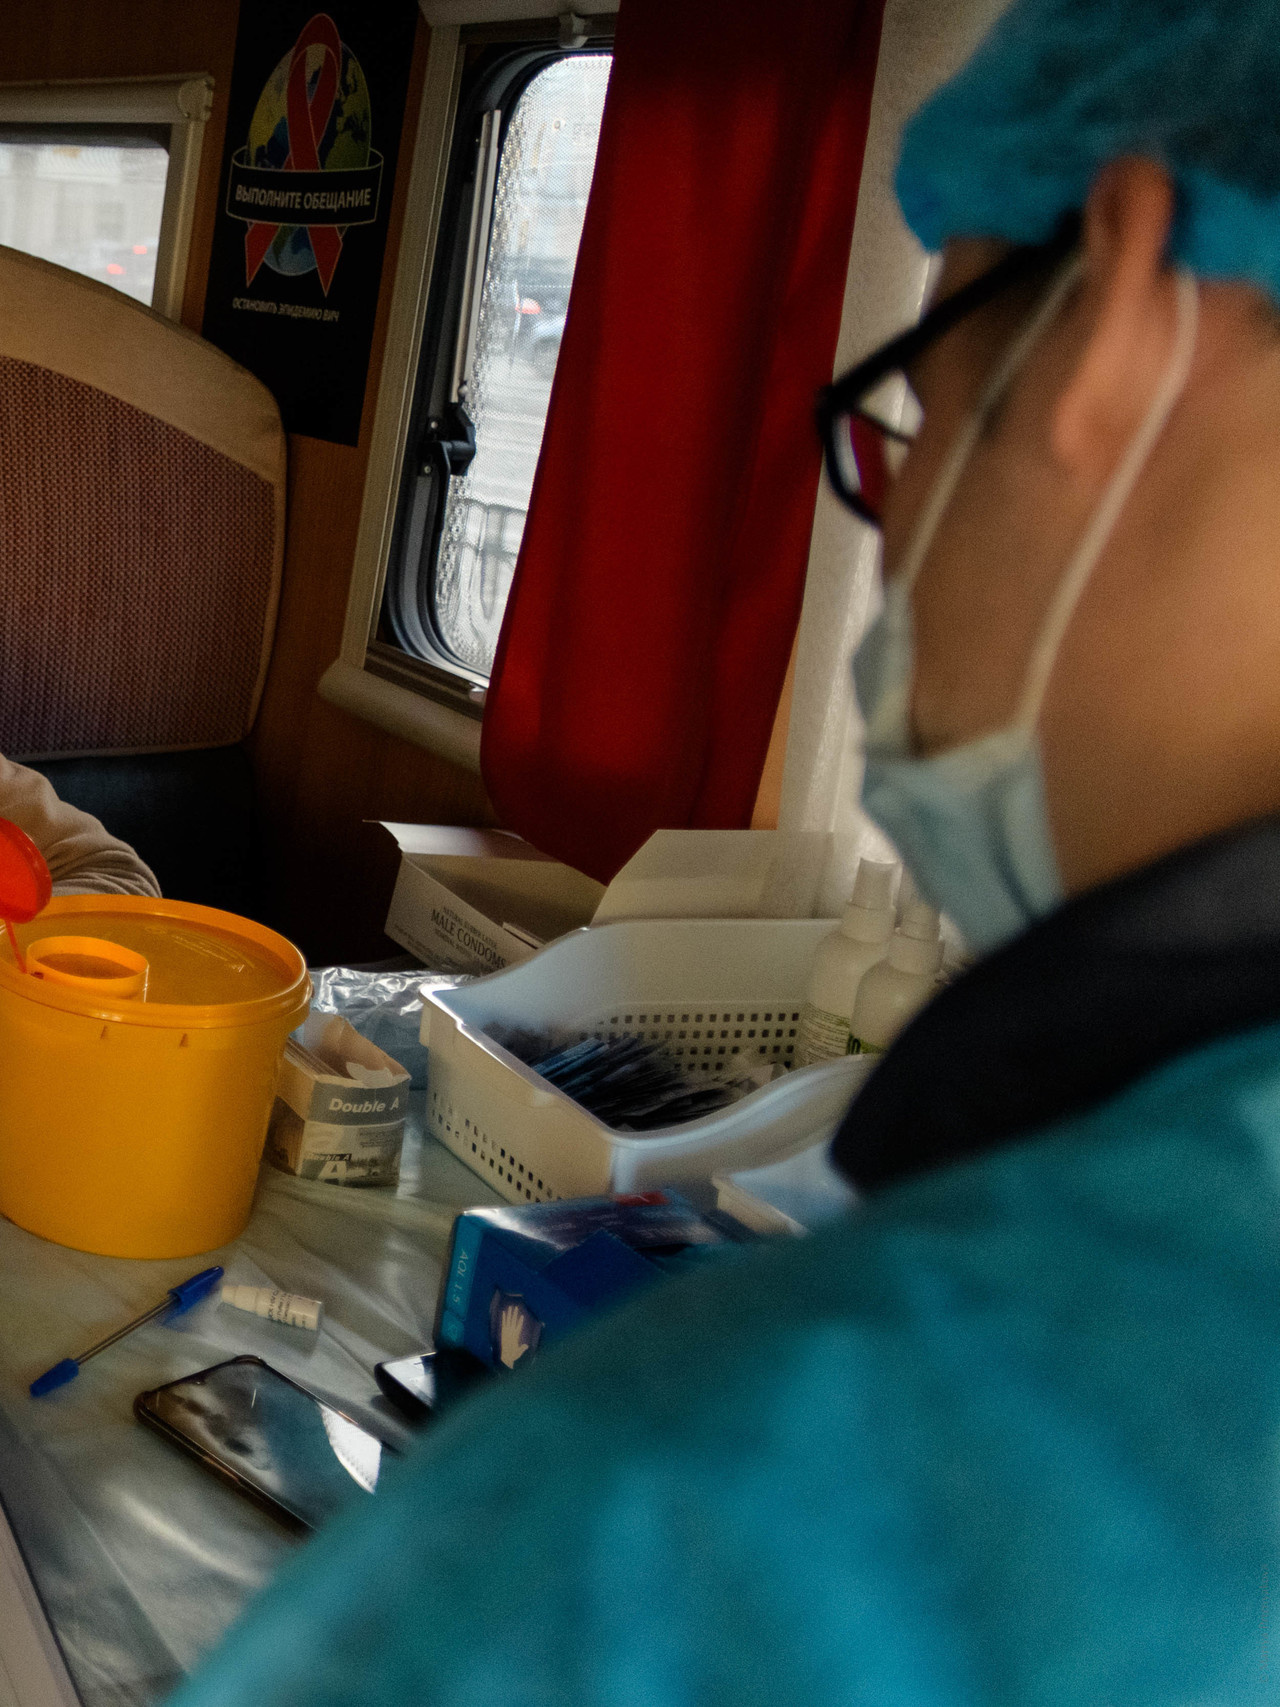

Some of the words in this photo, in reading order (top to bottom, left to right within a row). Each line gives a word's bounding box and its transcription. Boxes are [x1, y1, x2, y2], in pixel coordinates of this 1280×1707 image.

[235, 184, 302, 209] ВЫПОЛНИТЕ
[303, 188, 372, 213] ОБЕЩАНИЕ
[232, 297, 277, 314] ОСТАНОВИТЬ
[278, 303, 322, 319] ЭПИДЕМИЮ
[323, 309, 341, 322] ВИЧ
[430, 909, 455, 936] MALE
[457, 928, 507, 968] CONDOMS
[328, 1097, 386, 1113] Double
[390, 1097, 400, 1111] A
[456, 1249, 470, 1276] AQL
[452, 1284, 464, 1304] 1.5
